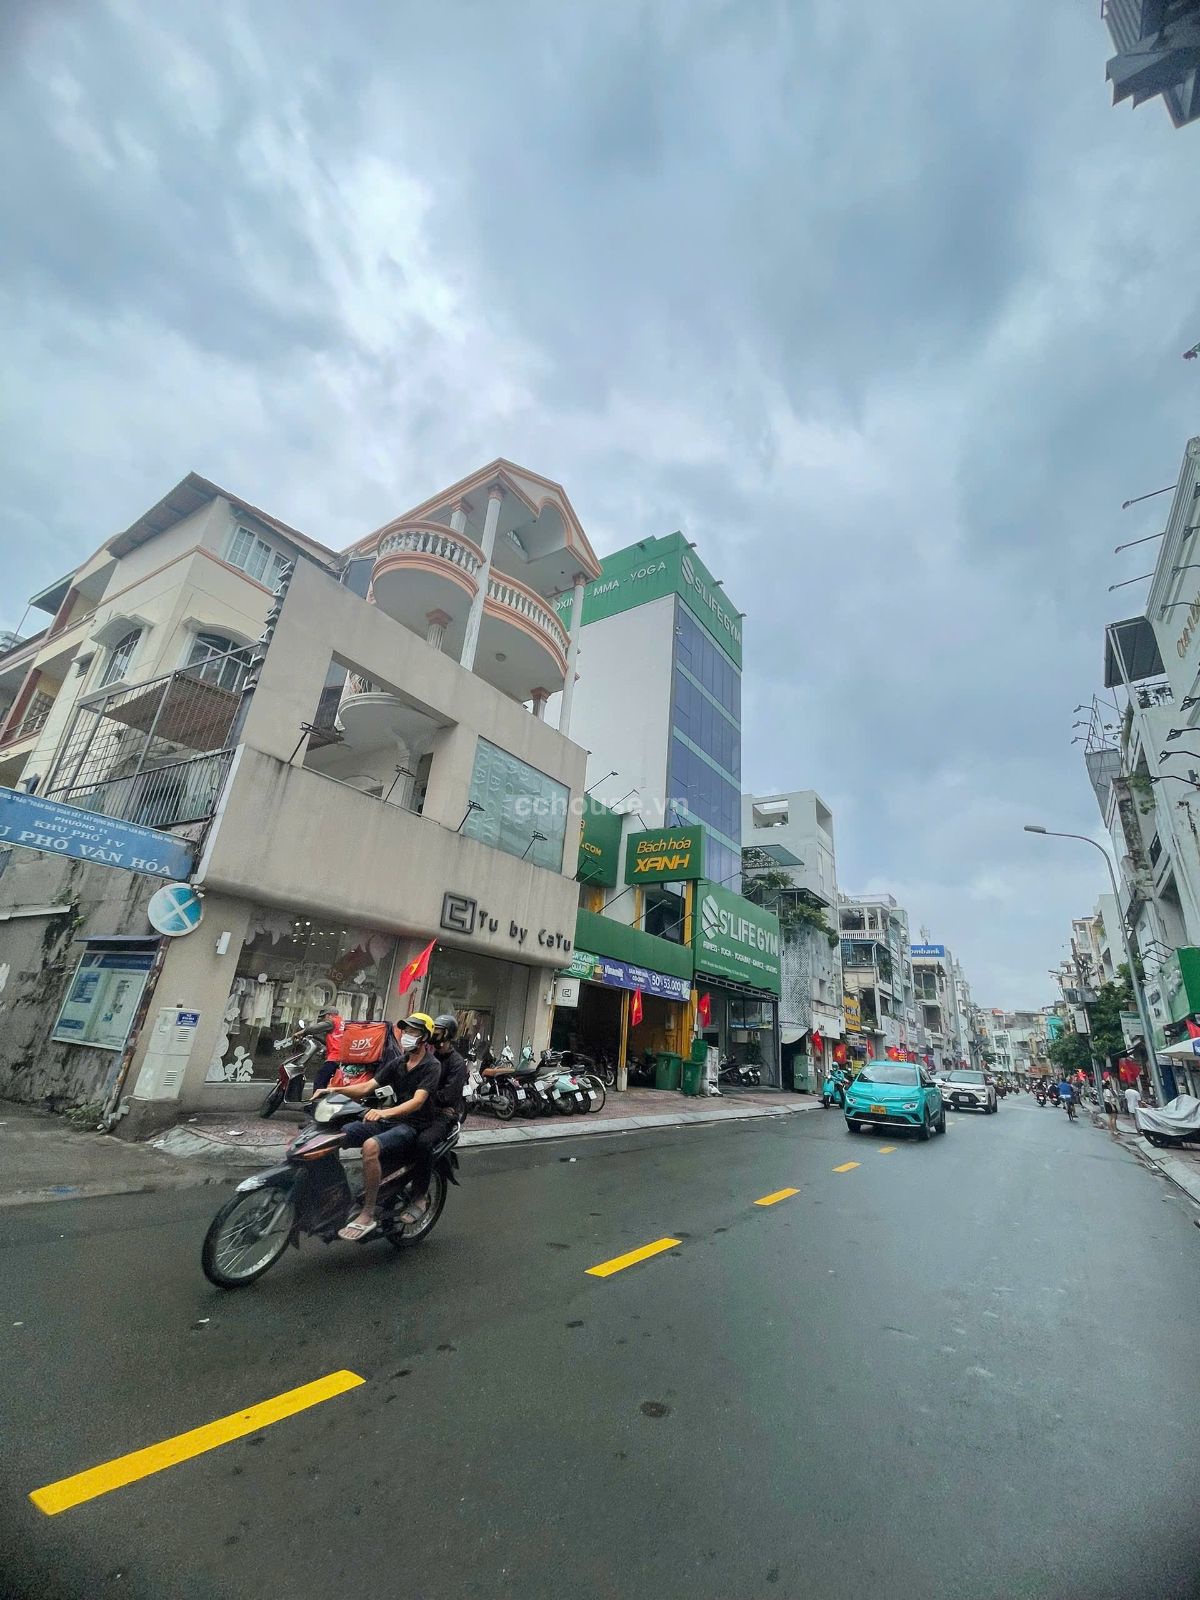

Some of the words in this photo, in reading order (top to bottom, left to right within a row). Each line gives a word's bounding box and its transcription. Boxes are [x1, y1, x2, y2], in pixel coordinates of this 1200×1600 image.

[593, 579, 620, 598] MMA
[630, 561, 666, 583] YOGA
[34, 820, 68, 832] KHU
[71, 829, 103, 842] PHỐ
[636, 838, 667, 854] Bách
[667, 835, 692, 850] hóa
[18, 830, 73, 850] PHỐ
[79, 844, 123, 864] VĂN
[129, 857, 172, 876] HÓA
[633, 853, 690, 873] XANH
[479, 910, 499, 932] Tu
[509, 920, 529, 944] by
[718, 909, 756, 948] S'LIFE
[757, 927, 779, 958] GYM
[351, 1037, 373, 1049] SPX
